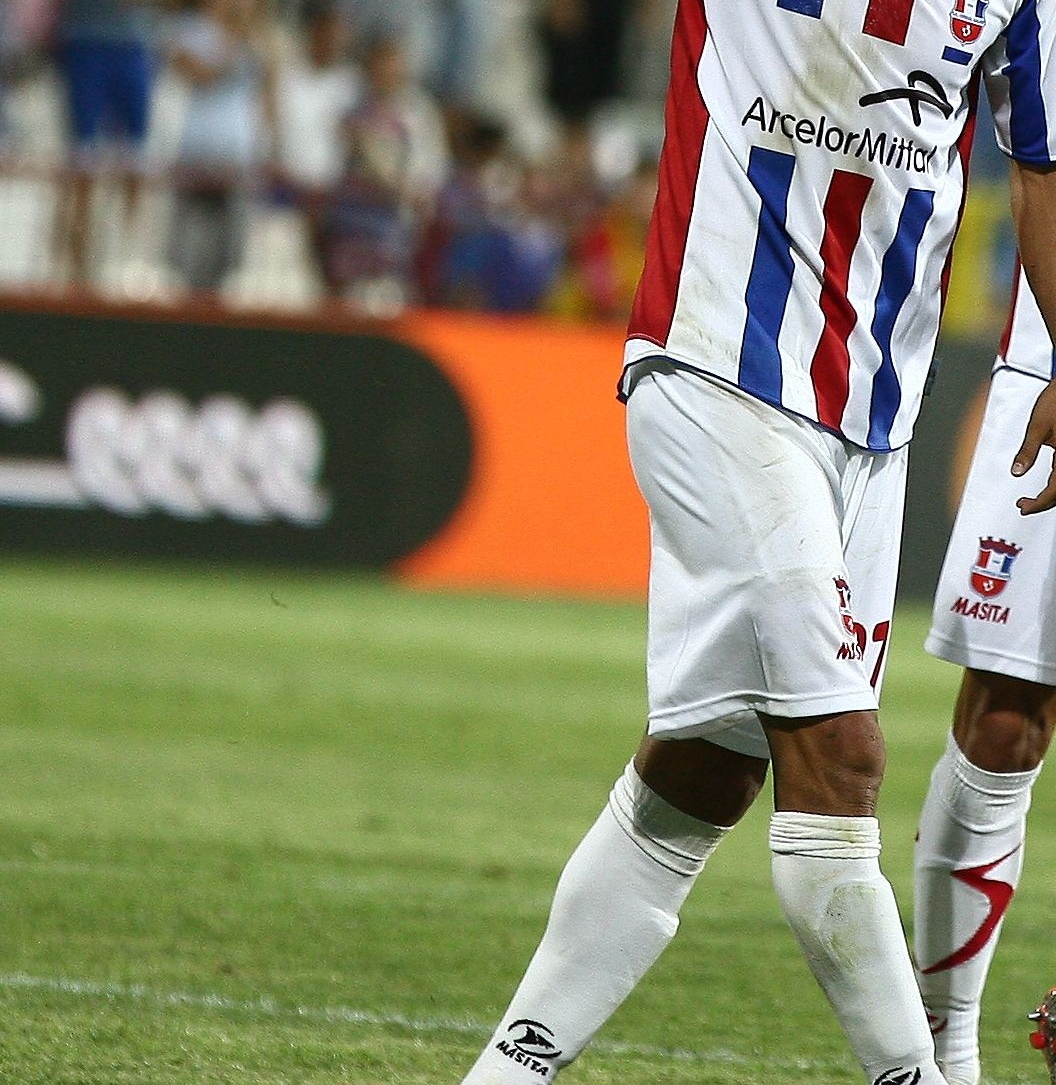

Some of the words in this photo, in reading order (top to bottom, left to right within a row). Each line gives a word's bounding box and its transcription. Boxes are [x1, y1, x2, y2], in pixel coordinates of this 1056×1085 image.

[741, 96, 937, 173] ArcelorMittal
[951, 597, 1010, 624] MASITA
[496, 1040, 549, 1076] MASITA
